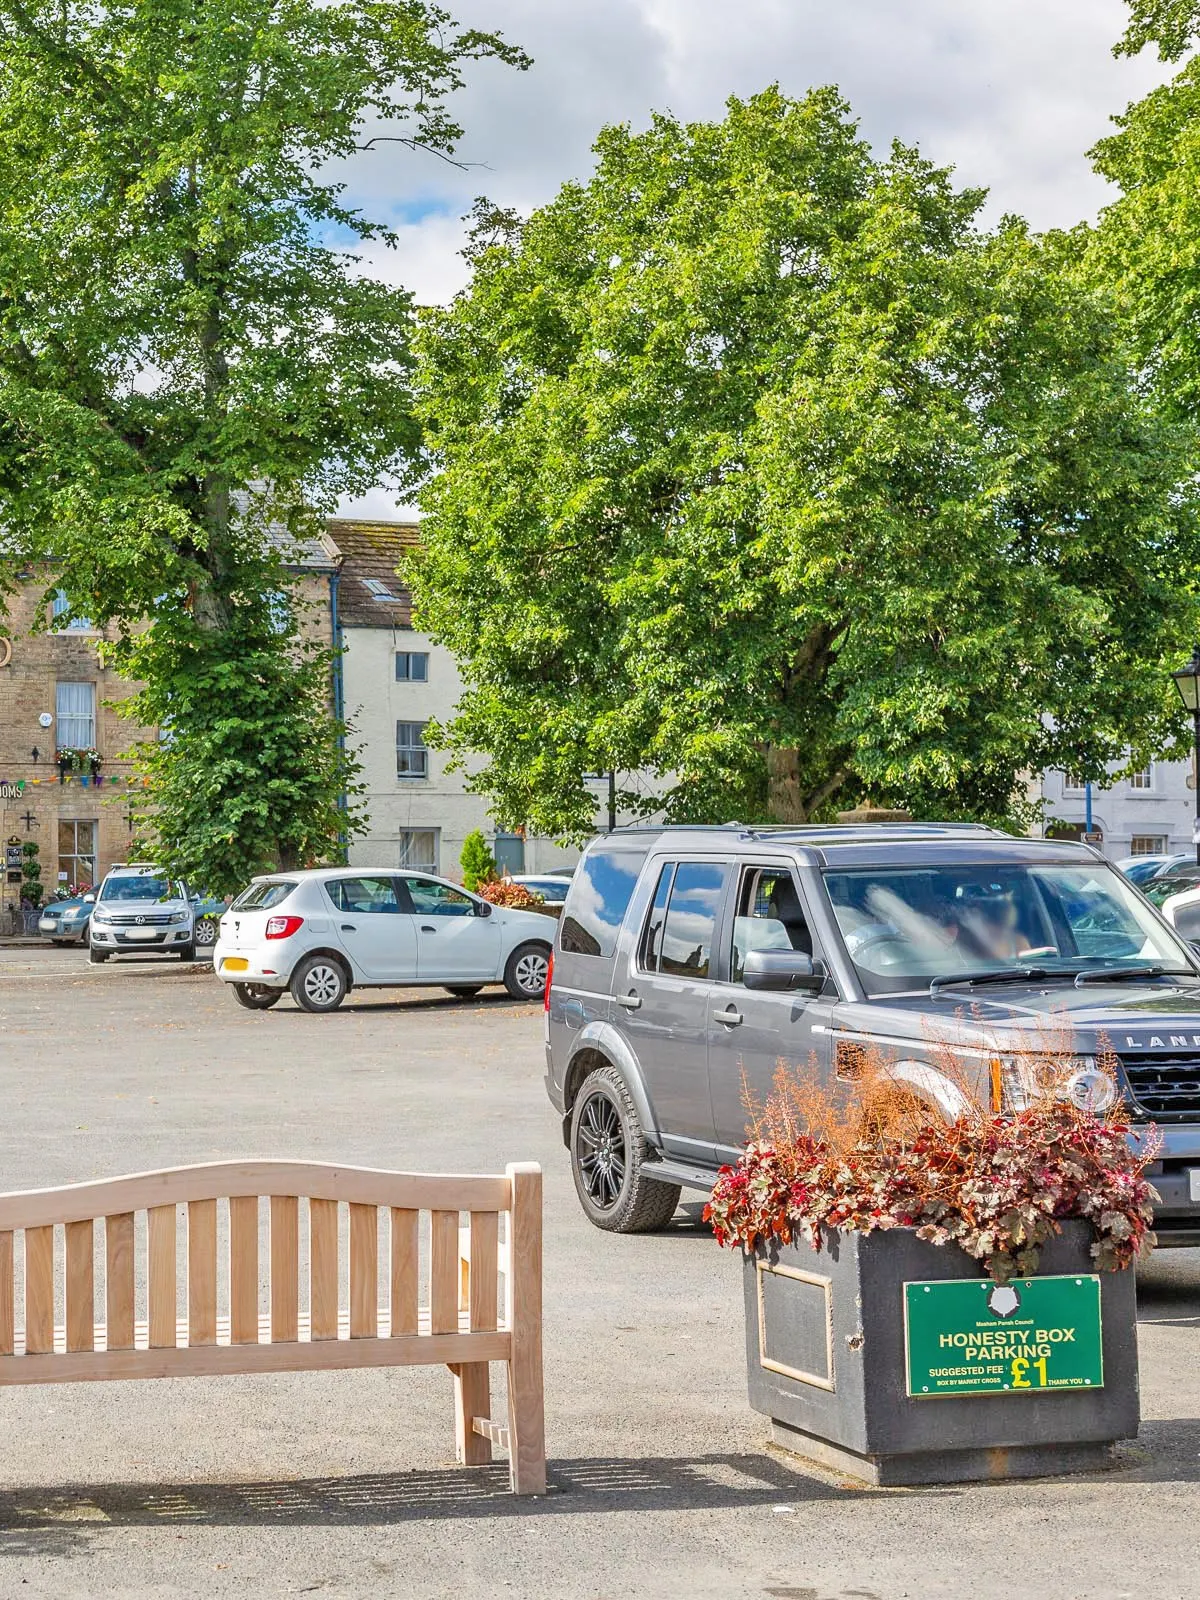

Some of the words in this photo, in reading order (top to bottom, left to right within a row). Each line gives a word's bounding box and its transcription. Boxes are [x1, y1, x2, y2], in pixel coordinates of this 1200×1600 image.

[939, 1330, 1030, 1348] HONESTY
[1035, 1328, 1076, 1343] BOX
[965, 1343, 1052, 1361] PARKING
[929, 1366, 985, 1377] SUGGESTED
[986, 1365, 1004, 1374] FEE
[1011, 1357, 1047, 1388] £1
